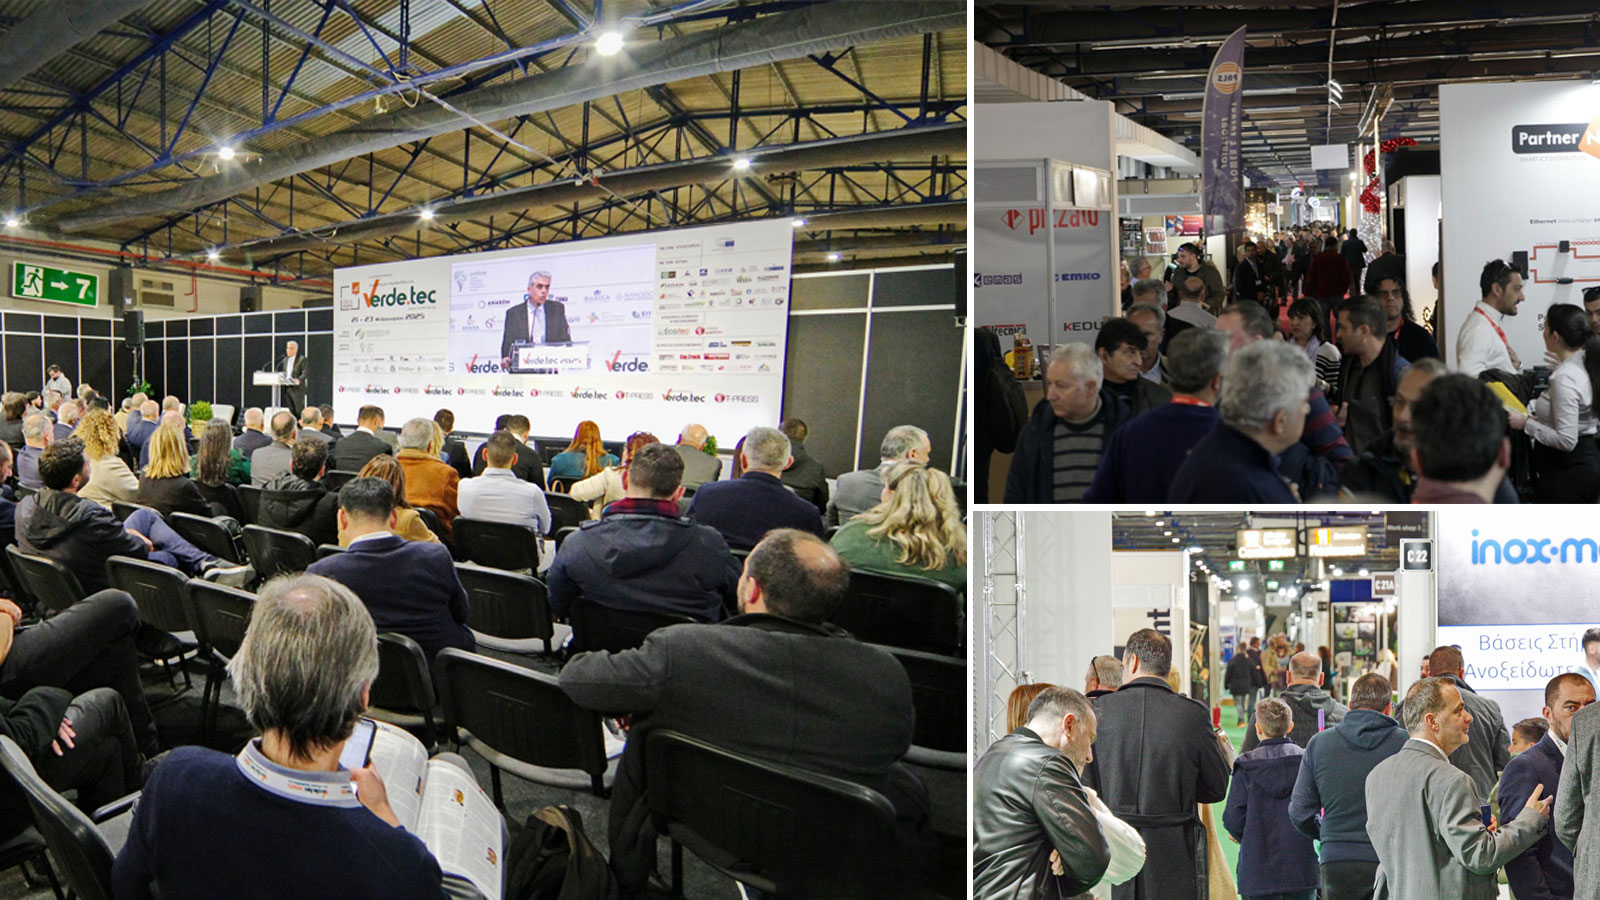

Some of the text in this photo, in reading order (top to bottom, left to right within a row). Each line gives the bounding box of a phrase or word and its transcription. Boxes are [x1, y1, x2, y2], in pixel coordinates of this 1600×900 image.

[1519, 131, 1580, 146] Partner
[1028, 208, 1099, 235] pizato
[76, 278, 91, 299] 7
[363, 279, 437, 308] Verde.tec
[570, 386, 608, 400] Verde.tec
[662, 388, 706, 403] Verde.tec
[1407, 550, 1428, 563] C 22
[1471, 528, 1600, 565] inox·m
[1375, 579, 1395, 590] C 21A
[1479, 633, 1543, 653] Βάσεις
[1465, 660, 1574, 682] Ανοξείδωτε
